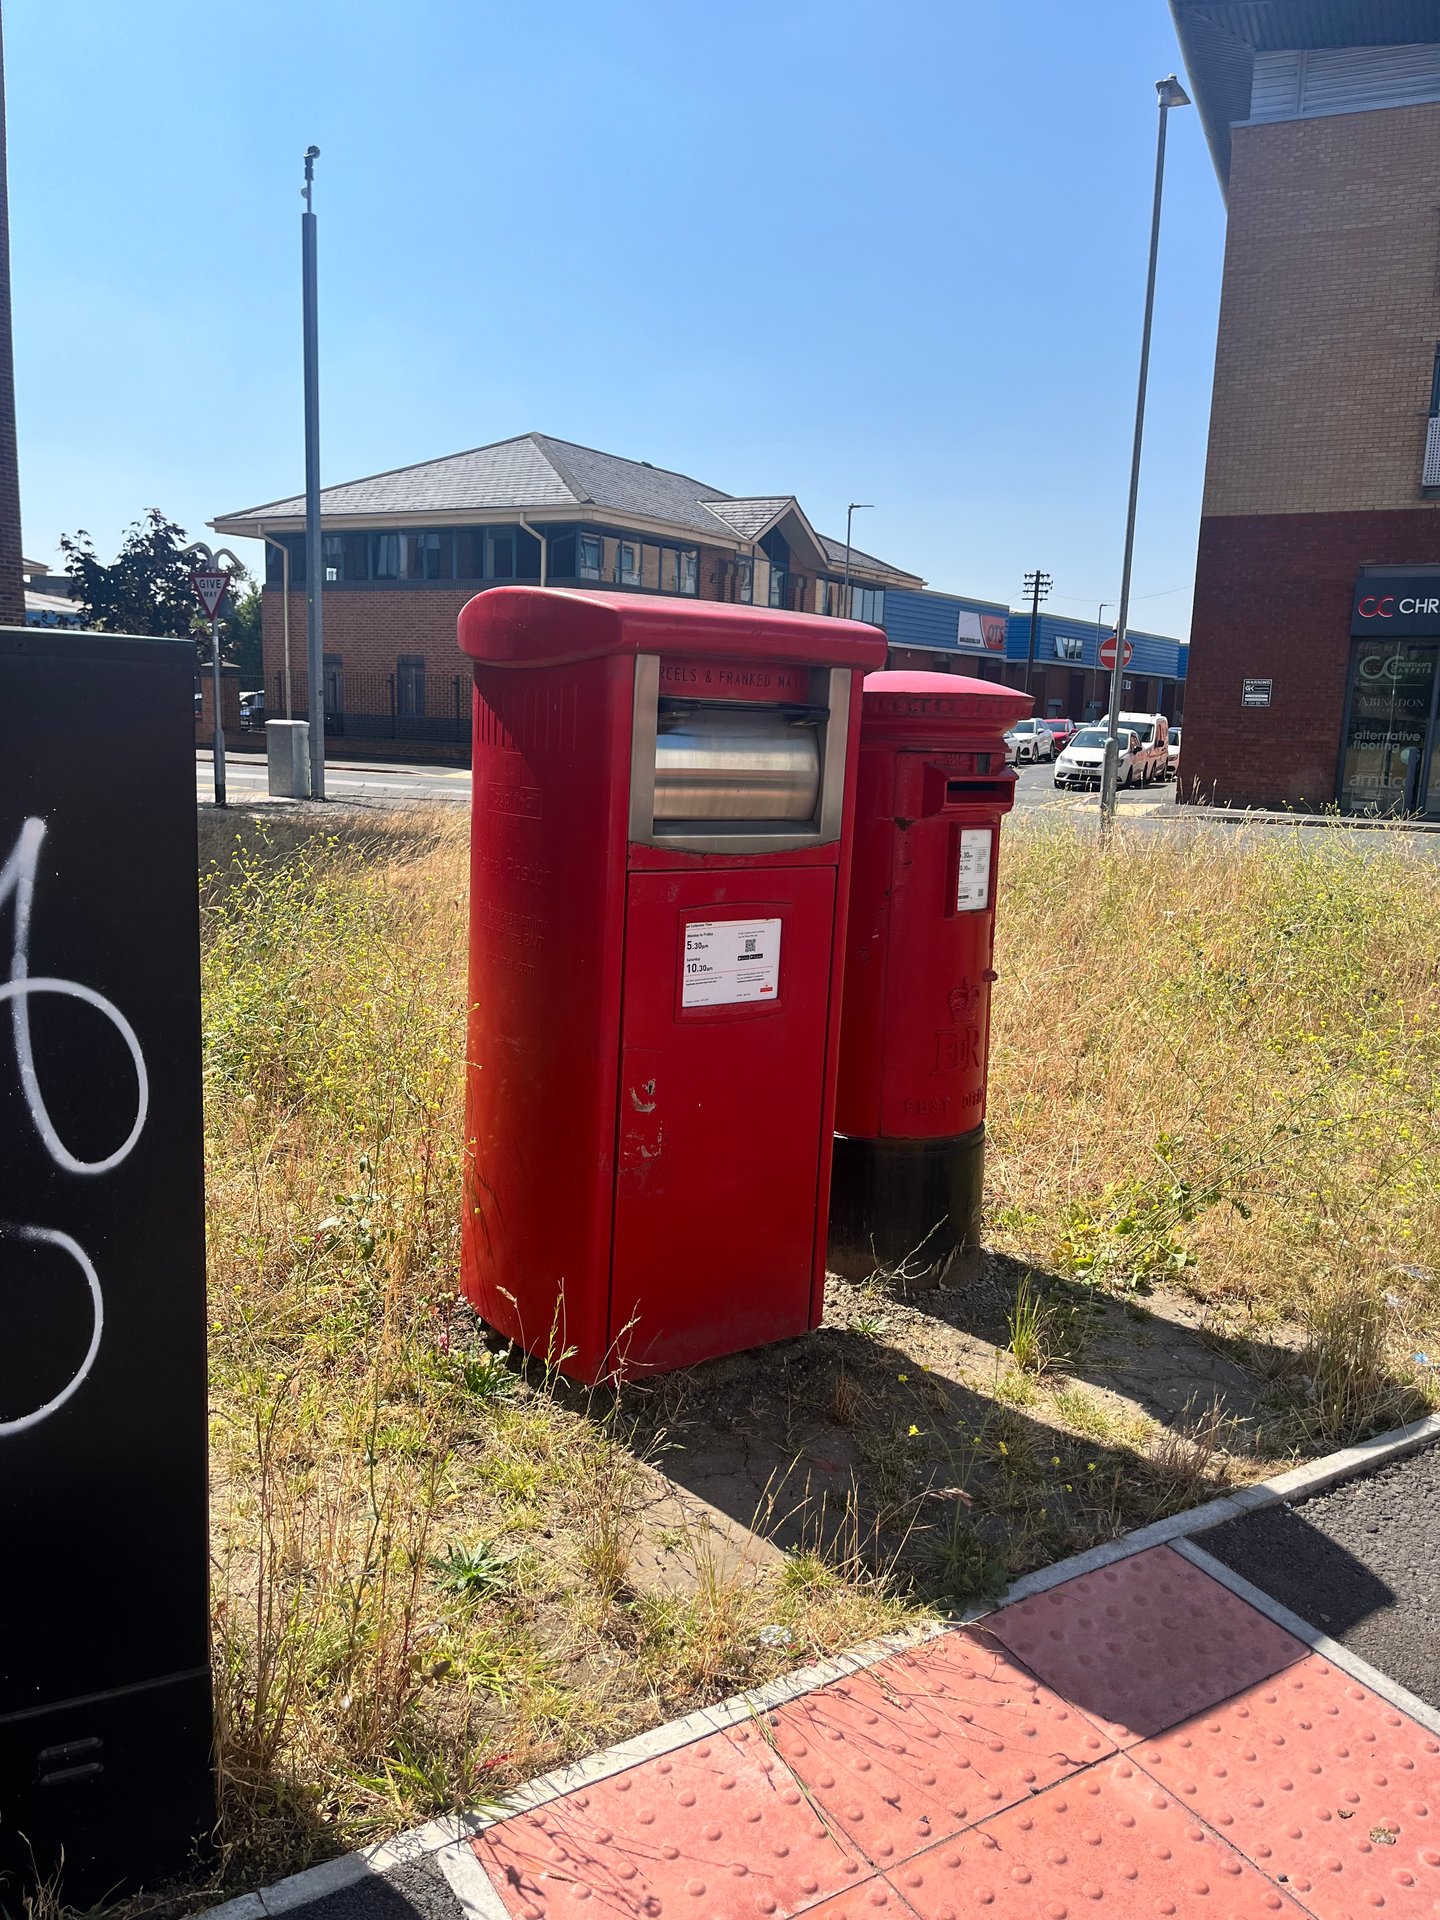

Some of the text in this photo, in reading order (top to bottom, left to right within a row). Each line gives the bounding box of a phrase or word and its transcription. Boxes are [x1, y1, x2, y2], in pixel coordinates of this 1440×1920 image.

[200, 579, 221, 588] GIVE
[1399, 597, 1440, 615] CHR
[660, 666, 697, 682] RCELS
[705, 669, 712, 683] &
[719, 670, 771, 687] FRANKED
[1358, 695, 1425, 708] ABINGDON
[1353, 729, 1421, 742] alternative
[1353, 740, 1401, 754] flooring
[1348, 772, 1406, 788] amtic
